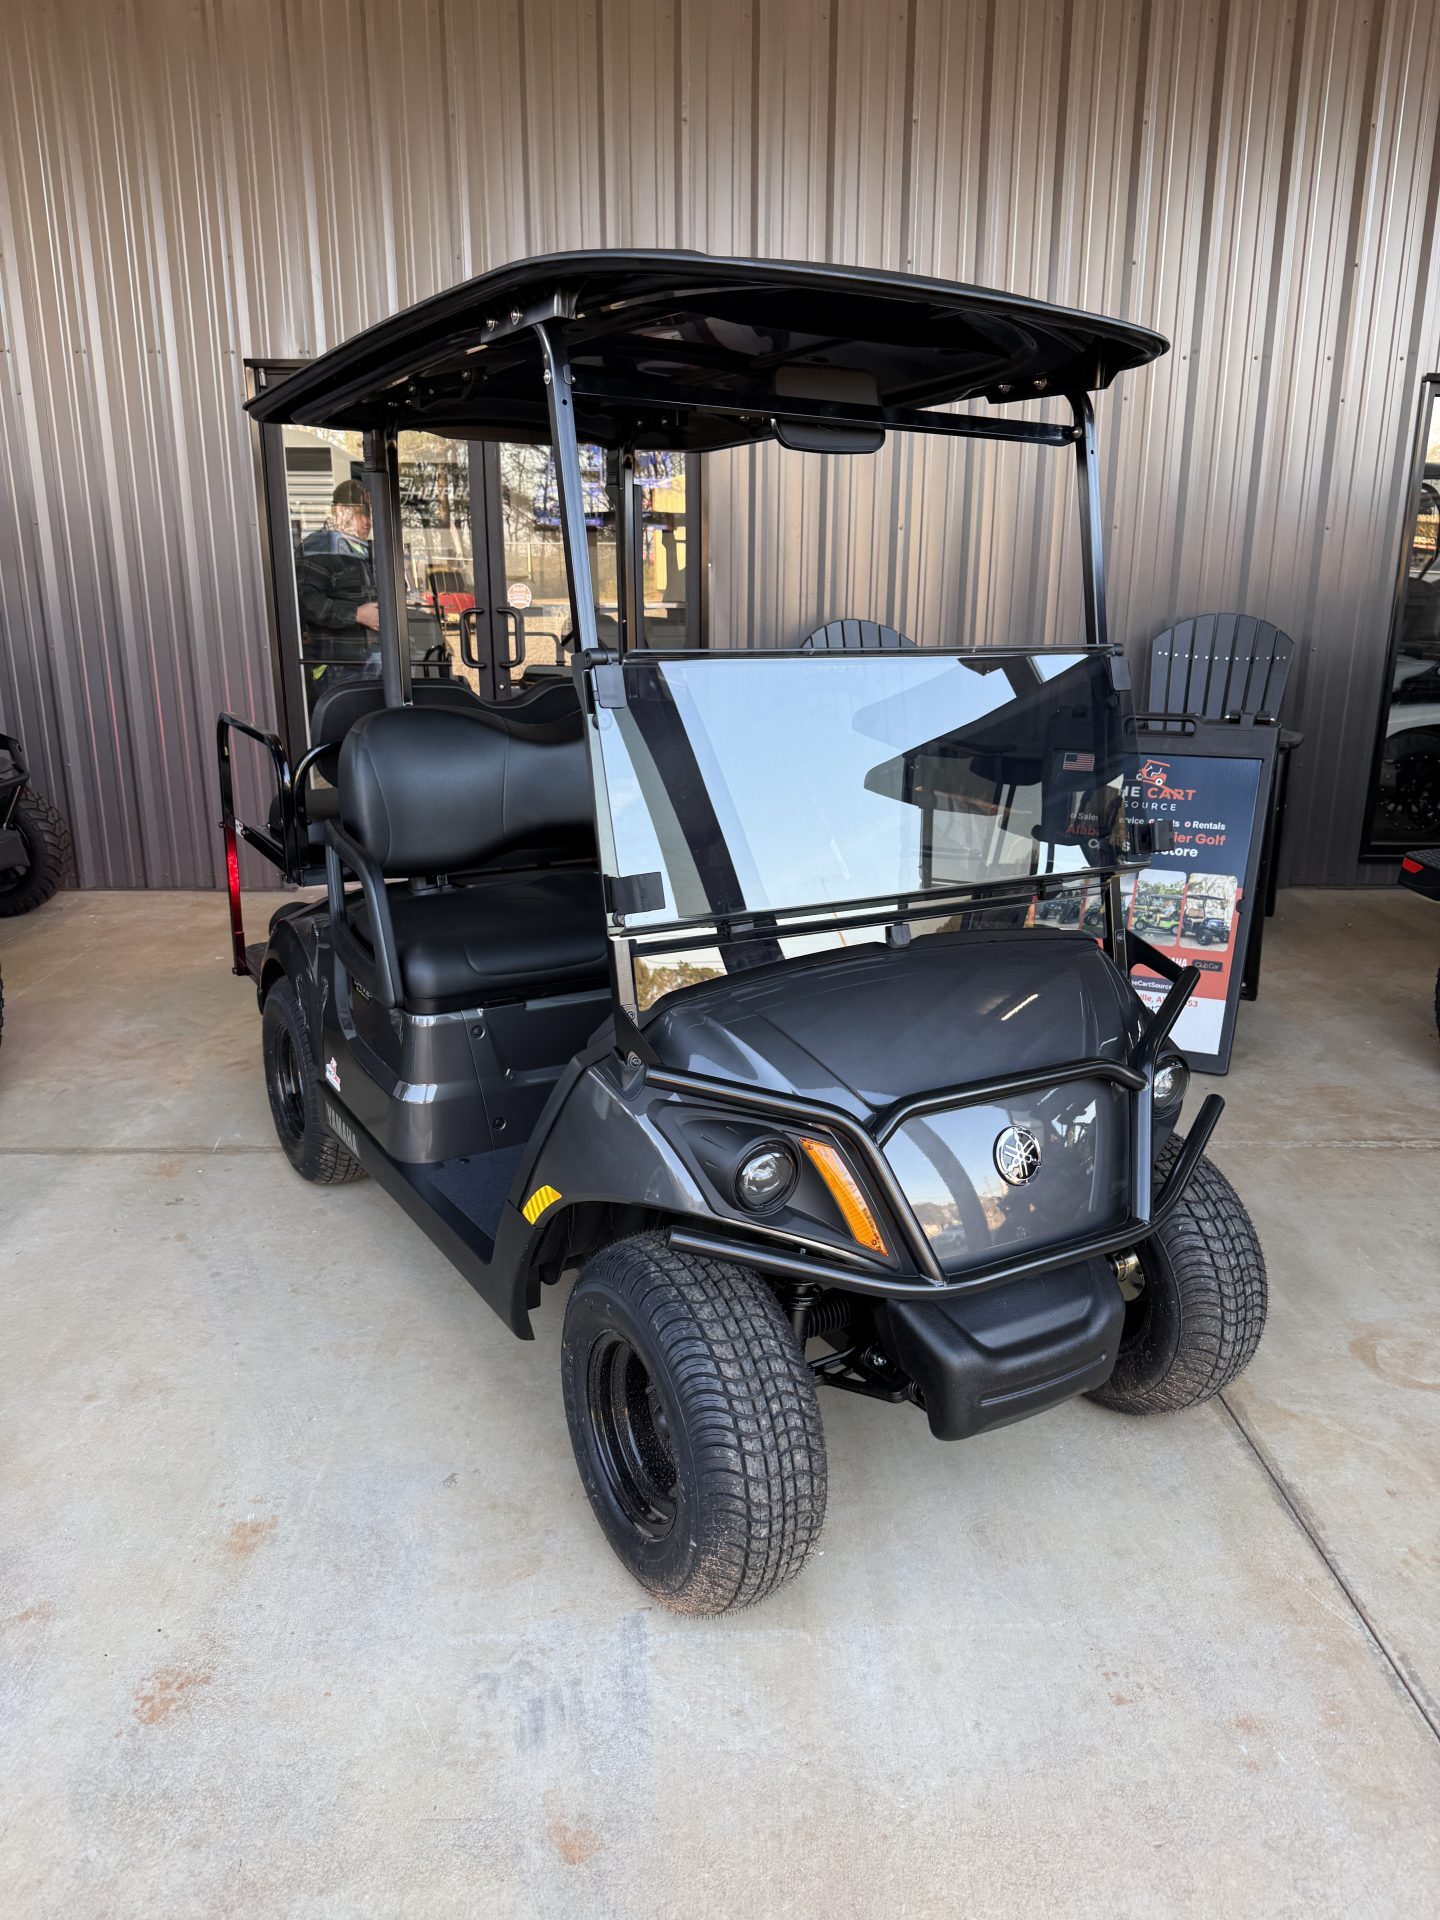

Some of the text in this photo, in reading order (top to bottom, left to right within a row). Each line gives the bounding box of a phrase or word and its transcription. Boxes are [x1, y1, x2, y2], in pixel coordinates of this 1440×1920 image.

[1118, 785, 1196, 801] HE CART
[1123, 800, 1177, 812] SOURCE
[1192, 820, 1226, 831] Rentals
[1195, 833, 1227, 847] Golf
[326, 1102, 361, 1159] YAMAHA
